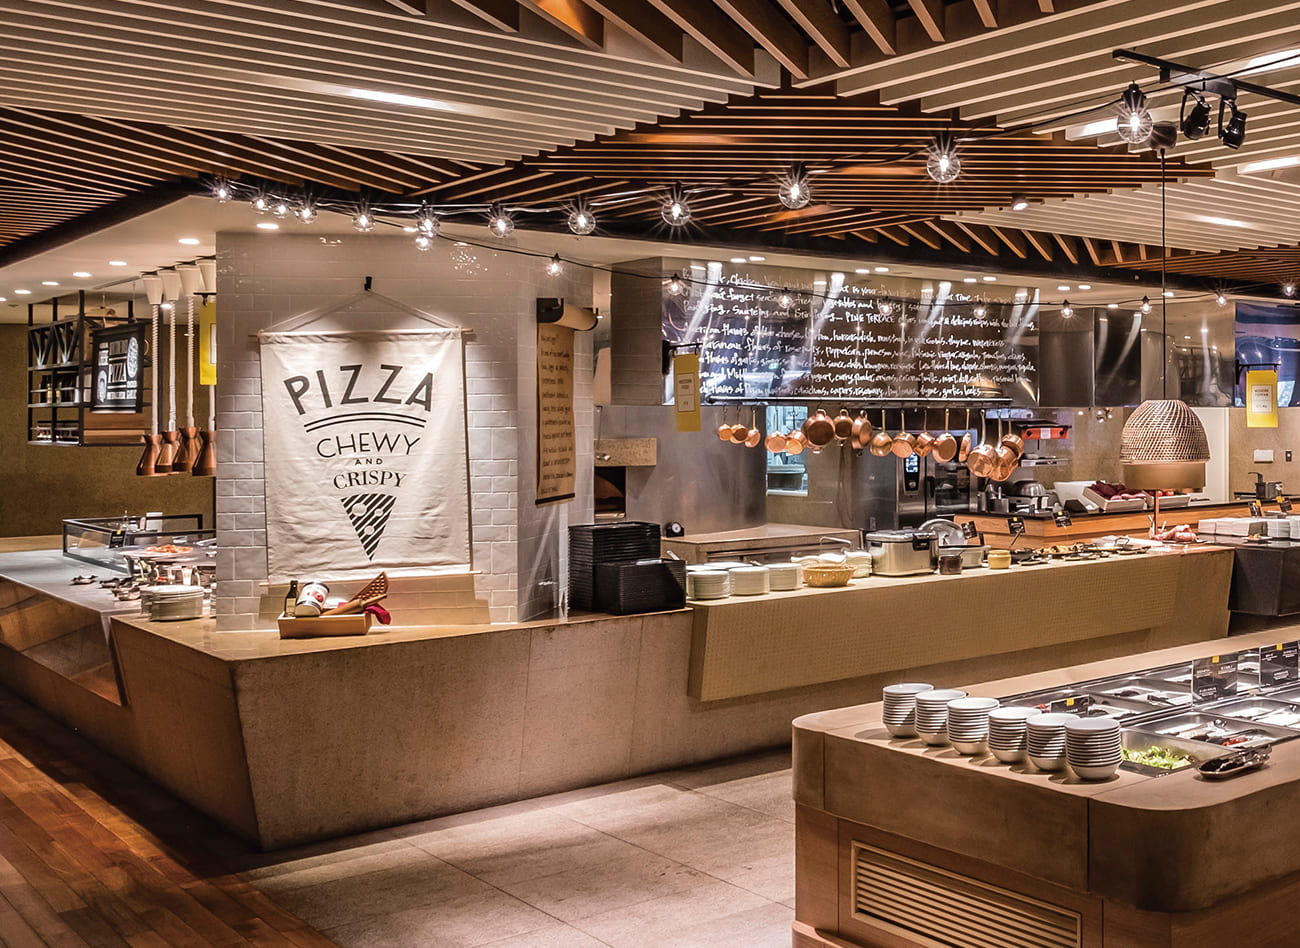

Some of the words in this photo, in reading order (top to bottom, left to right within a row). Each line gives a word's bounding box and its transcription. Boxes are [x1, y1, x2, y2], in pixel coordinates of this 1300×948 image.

[283, 363, 434, 417] PIZZA
[316, 431, 421, 458] CHEWY
[354, 458, 383, 466] AND
[333, 470, 407, 490] CRISPY
